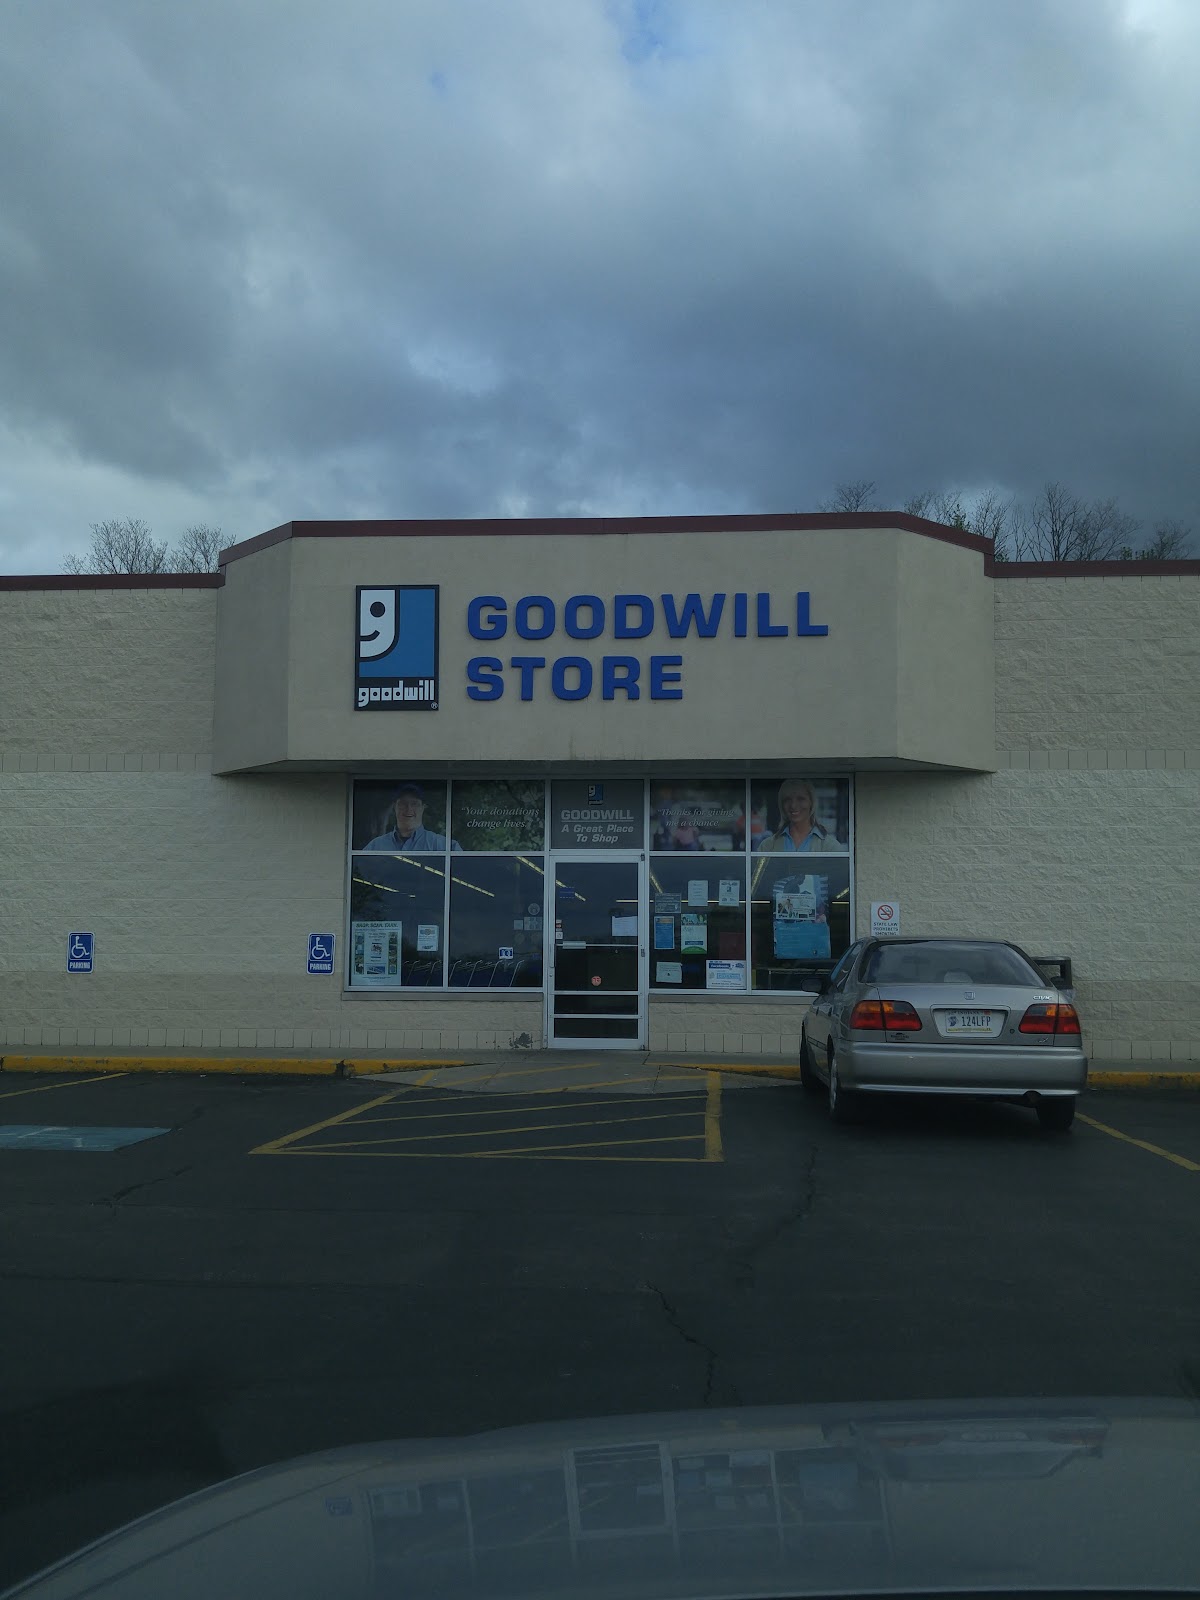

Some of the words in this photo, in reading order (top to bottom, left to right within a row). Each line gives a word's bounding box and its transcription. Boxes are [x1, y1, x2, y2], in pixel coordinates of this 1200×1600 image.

[467, 592, 829, 640] GOODWILL
[466, 655, 683, 701] STORE
[358, 679, 435, 708] goodwill
[489, 806, 539, 816] donations
[561, 809, 634, 820] GOODWILL
[707, 808, 734, 818] giving
[466, 819, 502, 830] change
[561, 824, 570, 833] A
[573, 824, 603, 833] Great
[606, 824, 634, 833] Place
[576, 833, 588, 843] To
[591, 833, 618, 844] Shop
[69, 961, 91, 969] PARKING
[309, 963, 332, 971] PARKING
[961, 1016, 991, 1027] 124LFP
